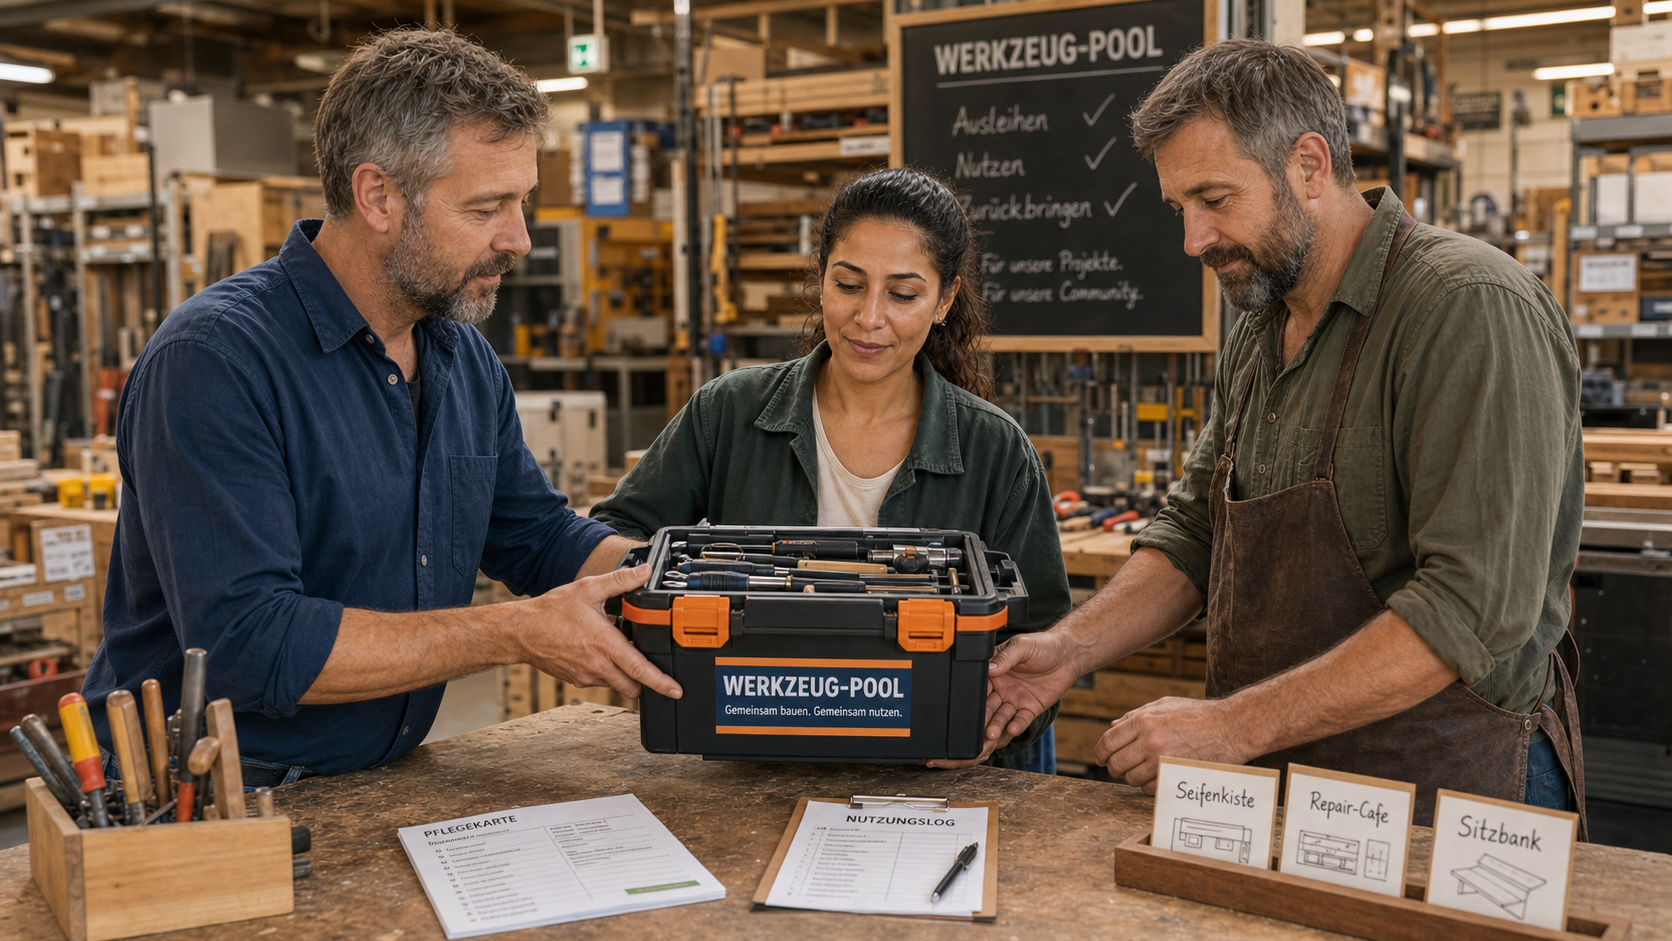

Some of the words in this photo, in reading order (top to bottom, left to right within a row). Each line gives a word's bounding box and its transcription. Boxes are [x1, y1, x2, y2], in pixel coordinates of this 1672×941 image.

[934, 25, 1163, 75] WERKZEUG-POOL
[951, 103, 1049, 137] Ausleihen
[955, 151, 1025, 178] Nutzen
[980, 252, 1006, 274] Für
[1009, 258, 1053, 273] unsere
[1058, 249, 1123, 280] Projekte.
[981, 281, 1006, 302] Für
[1009, 288, 1053, 303] unsere
[1059, 280, 1143, 310] Community.
[723, 675, 904, 698] WERKZEUG-POOL
[725, 705, 778, 716] Gemeinsam
[780, 706, 811, 717] bauen.
[813, 706, 867, 717] Gemeinsam
[869, 708, 902, 717] nutzen.
[1176, 781, 1255, 808] Seifenkiste
[846, 815, 955, 827] NUTZUNGSLOG
[1310, 791, 1389, 827] Repair-Cafe
[424, 815, 517, 838] PFLEGEKARTE
[1457, 815, 1542, 852] Sitzbank
